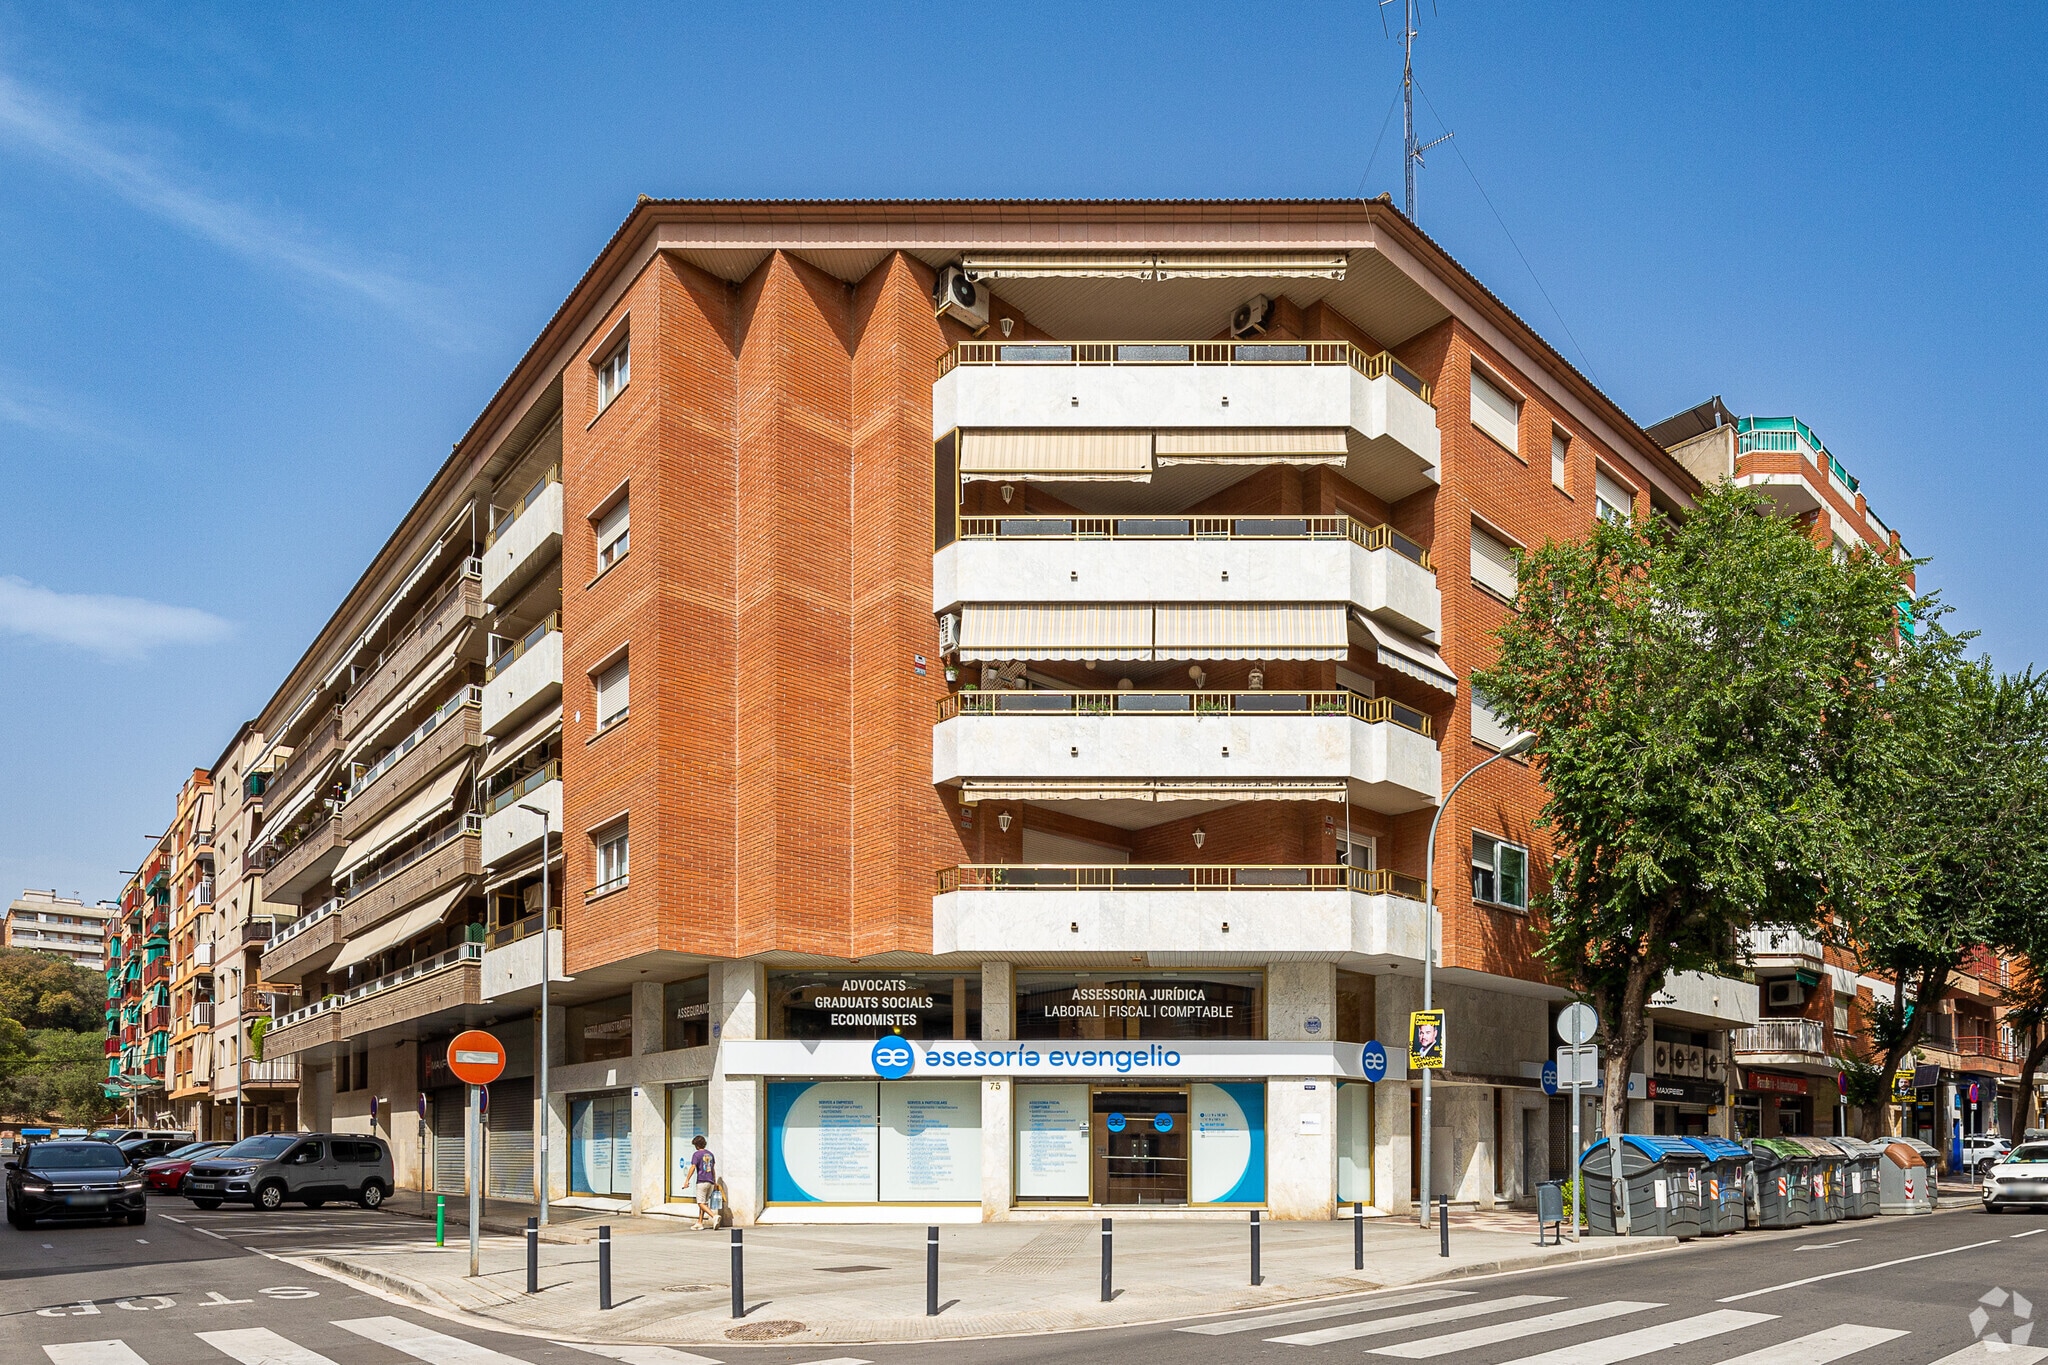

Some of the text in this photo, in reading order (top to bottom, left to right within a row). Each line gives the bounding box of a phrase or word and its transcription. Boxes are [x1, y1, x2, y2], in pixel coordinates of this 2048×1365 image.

[842, 980, 906, 991] ADVOCATS
[1072, 986, 1206, 1001] ASSESSORIA JURÍDICA
[815, 997, 933, 1009] GRADUATS SOCIALS
[1044, 1005, 1099, 1018] LABORAL
[1109, 1005, 1151, 1018] FISCAL
[1160, 1005, 1234, 1018] COMPTABLE
[831, 1014, 917, 1026] ECONOMISTES
[925, 1043, 1040, 1067] asesoría
[1049, 1044, 1180, 1073] evangelio
[990, 1082, 1001, 1091] 75
[35, 1285, 320, 1317] STOP
